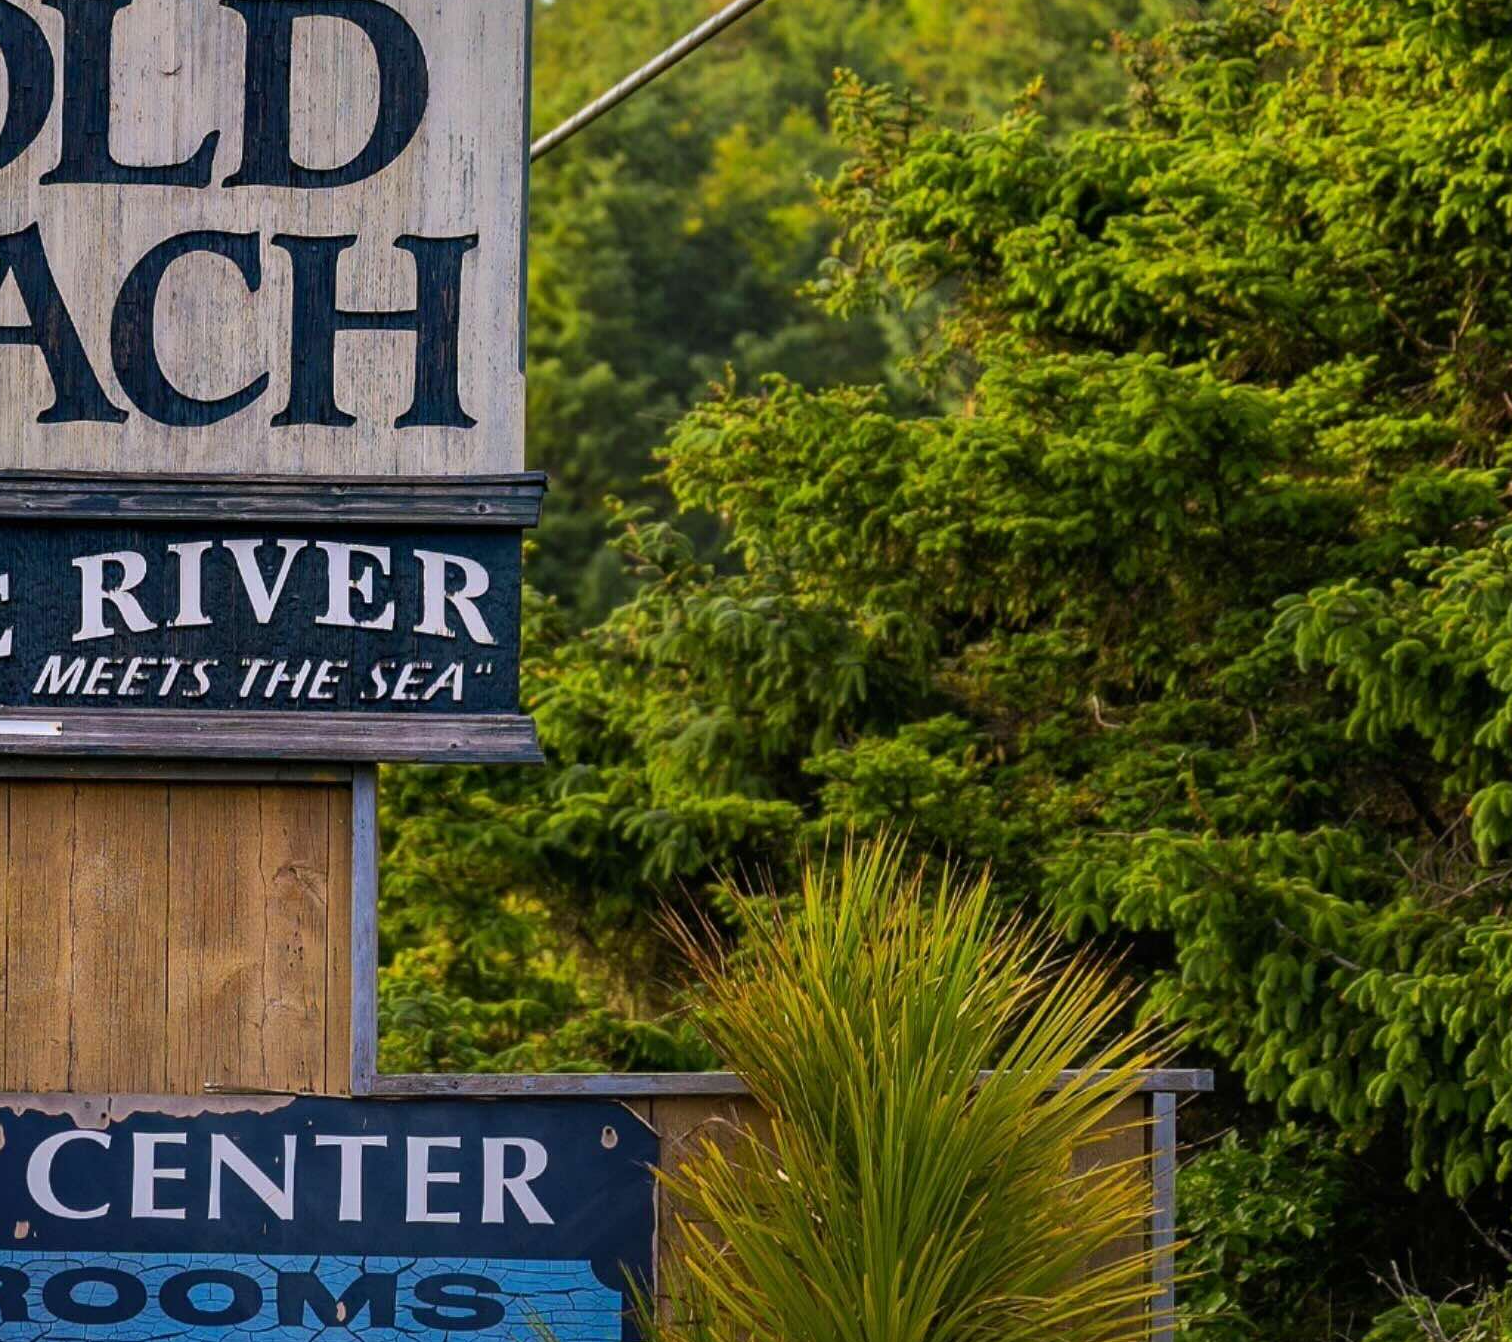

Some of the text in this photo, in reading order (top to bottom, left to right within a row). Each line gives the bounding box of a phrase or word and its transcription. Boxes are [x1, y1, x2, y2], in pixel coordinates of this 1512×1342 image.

[71, 539, 497, 645] RIVER
[32, 656, 221, 698] MEETS
[239, 659, 349, 700] THE
[26, 1129, 554, 1225] CENTER
